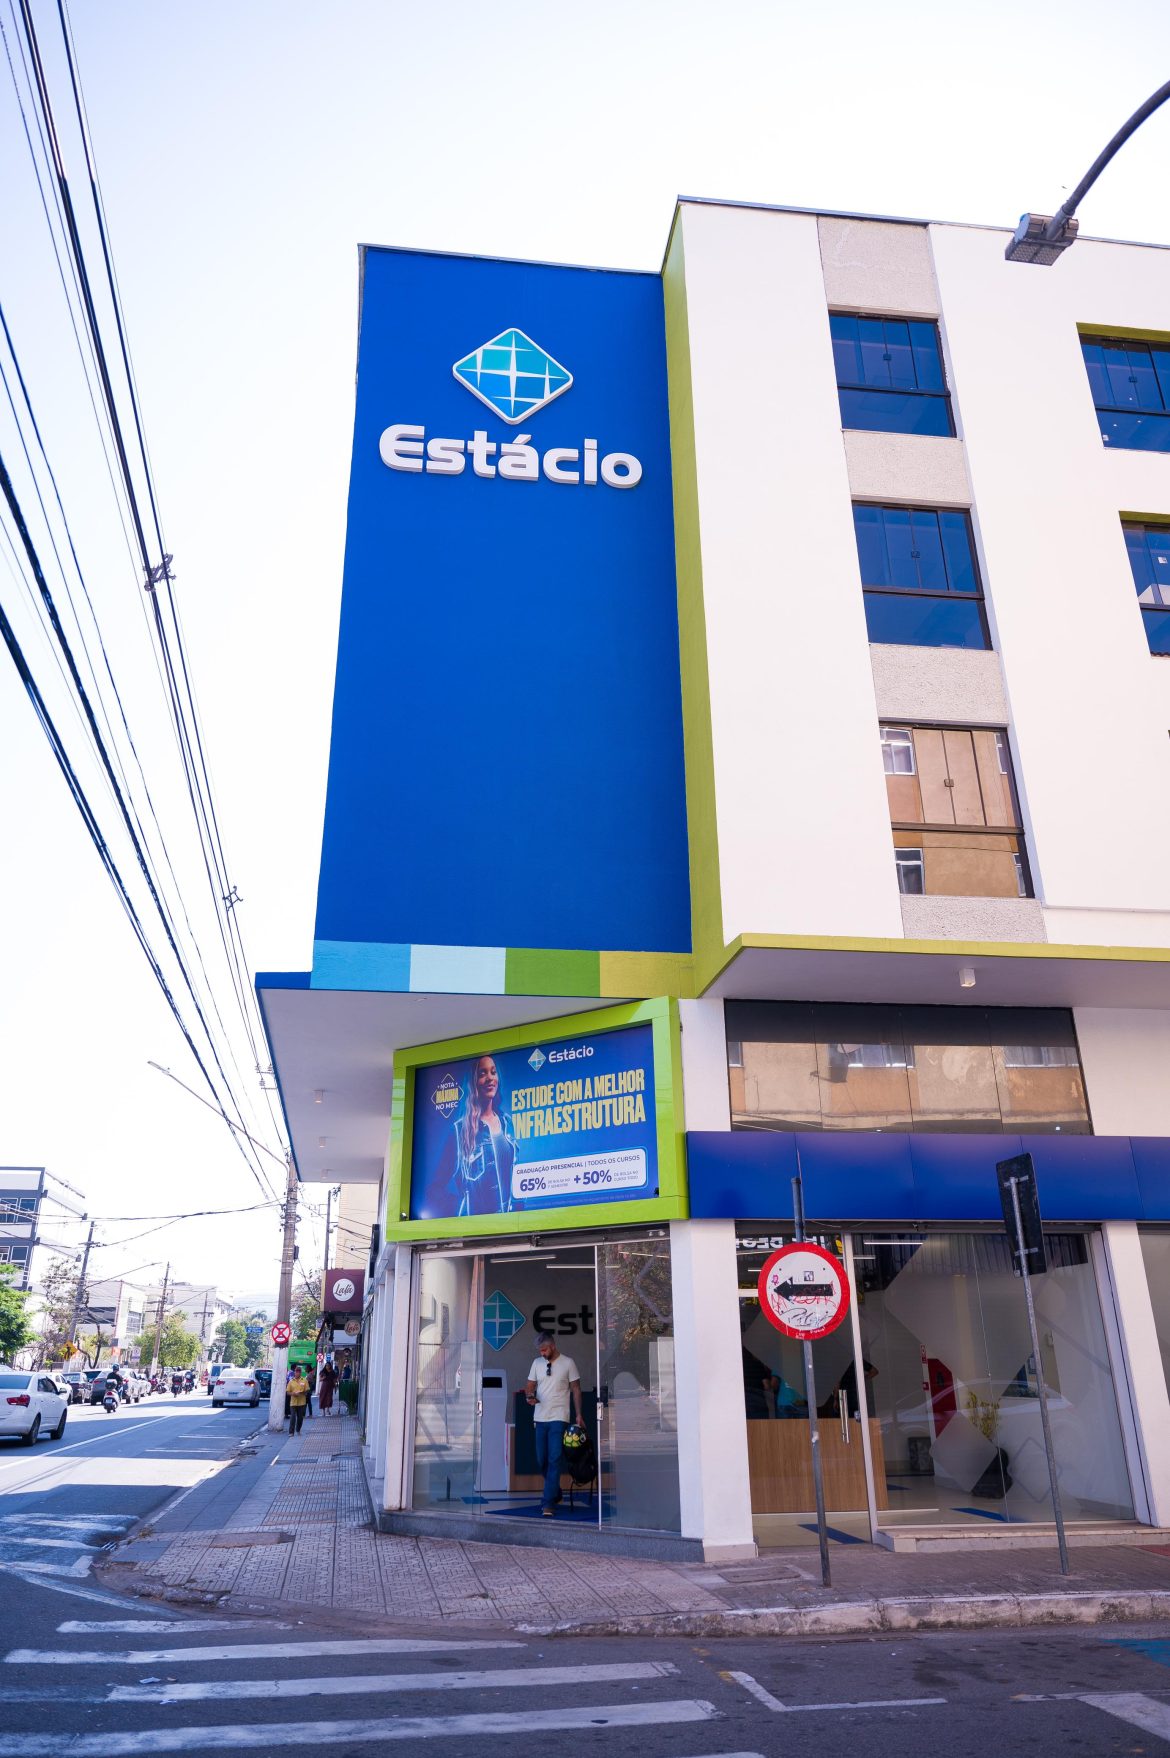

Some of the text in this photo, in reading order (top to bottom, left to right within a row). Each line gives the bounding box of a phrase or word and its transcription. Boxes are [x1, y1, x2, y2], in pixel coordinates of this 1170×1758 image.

[379, 424, 642, 489] Estácio
[548, 1045, 594, 1063] Estácio
[511, 1068, 645, 1111] ESTUDE COM A MELHOR
[511, 1094, 646, 1139] INFRAESTRUTURA
[516, 1165, 550, 1175] GRADUAÇÃO
[616, 1154, 640, 1163] CURSOS
[520, 1177, 546, 1191] 65%
[532, 1304, 594, 1336] Est
